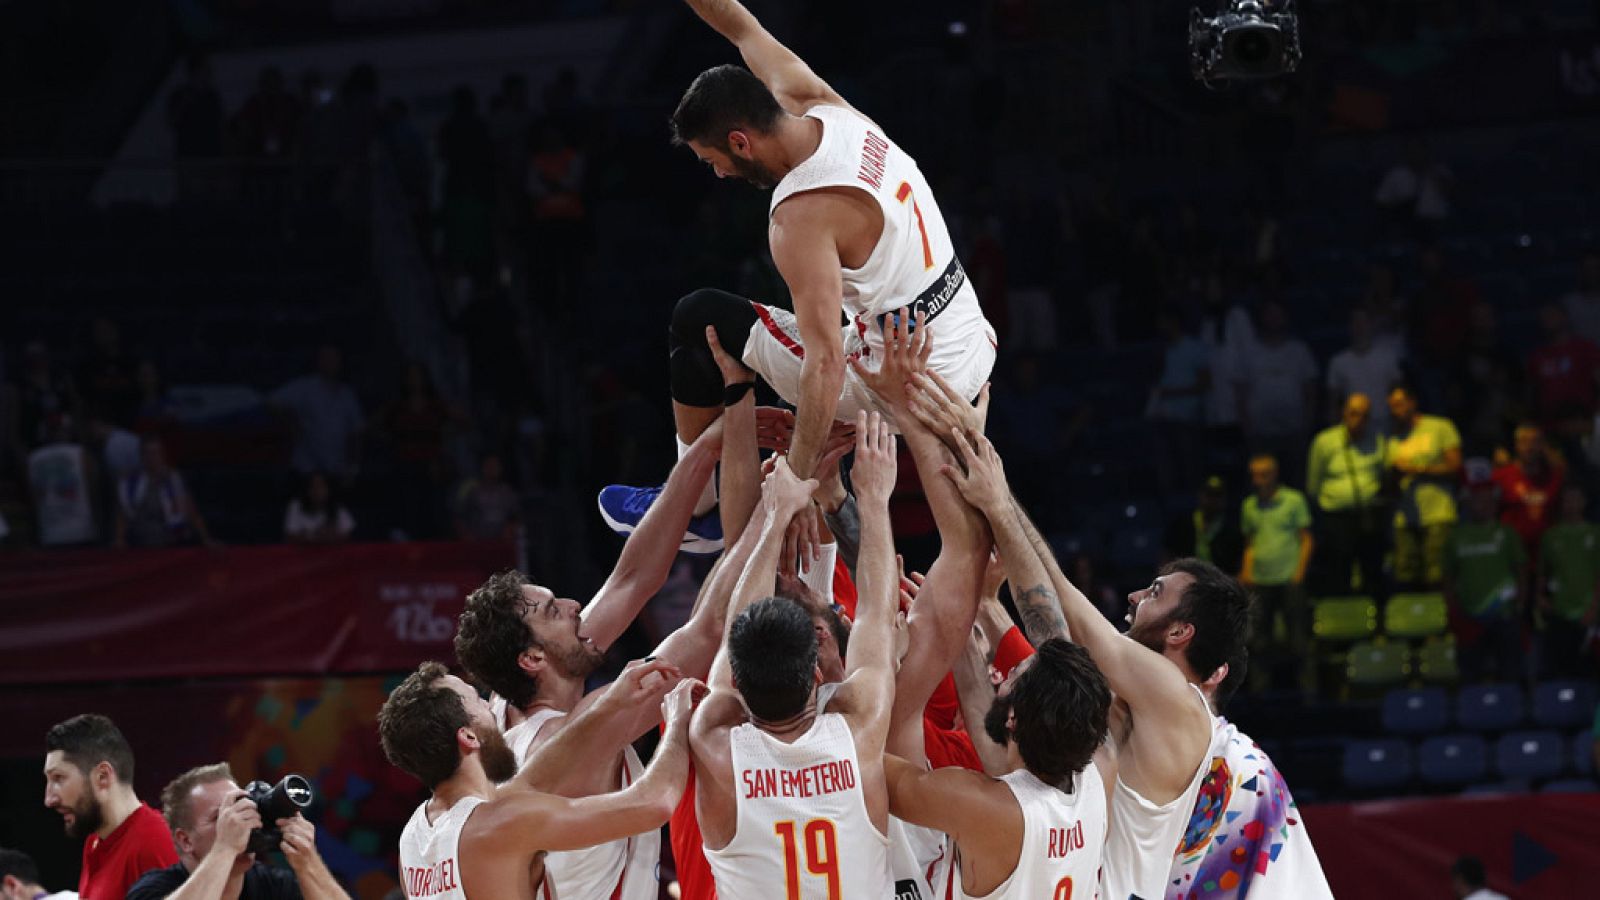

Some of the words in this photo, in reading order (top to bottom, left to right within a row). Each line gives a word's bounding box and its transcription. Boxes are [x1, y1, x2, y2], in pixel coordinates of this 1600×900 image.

[857, 130, 889, 192] NAVARRO
[894, 180, 935, 272] 7
[743, 769, 777, 799] SAN
[780, 759, 856, 799] EMETERIO
[774, 817, 842, 900] 19
